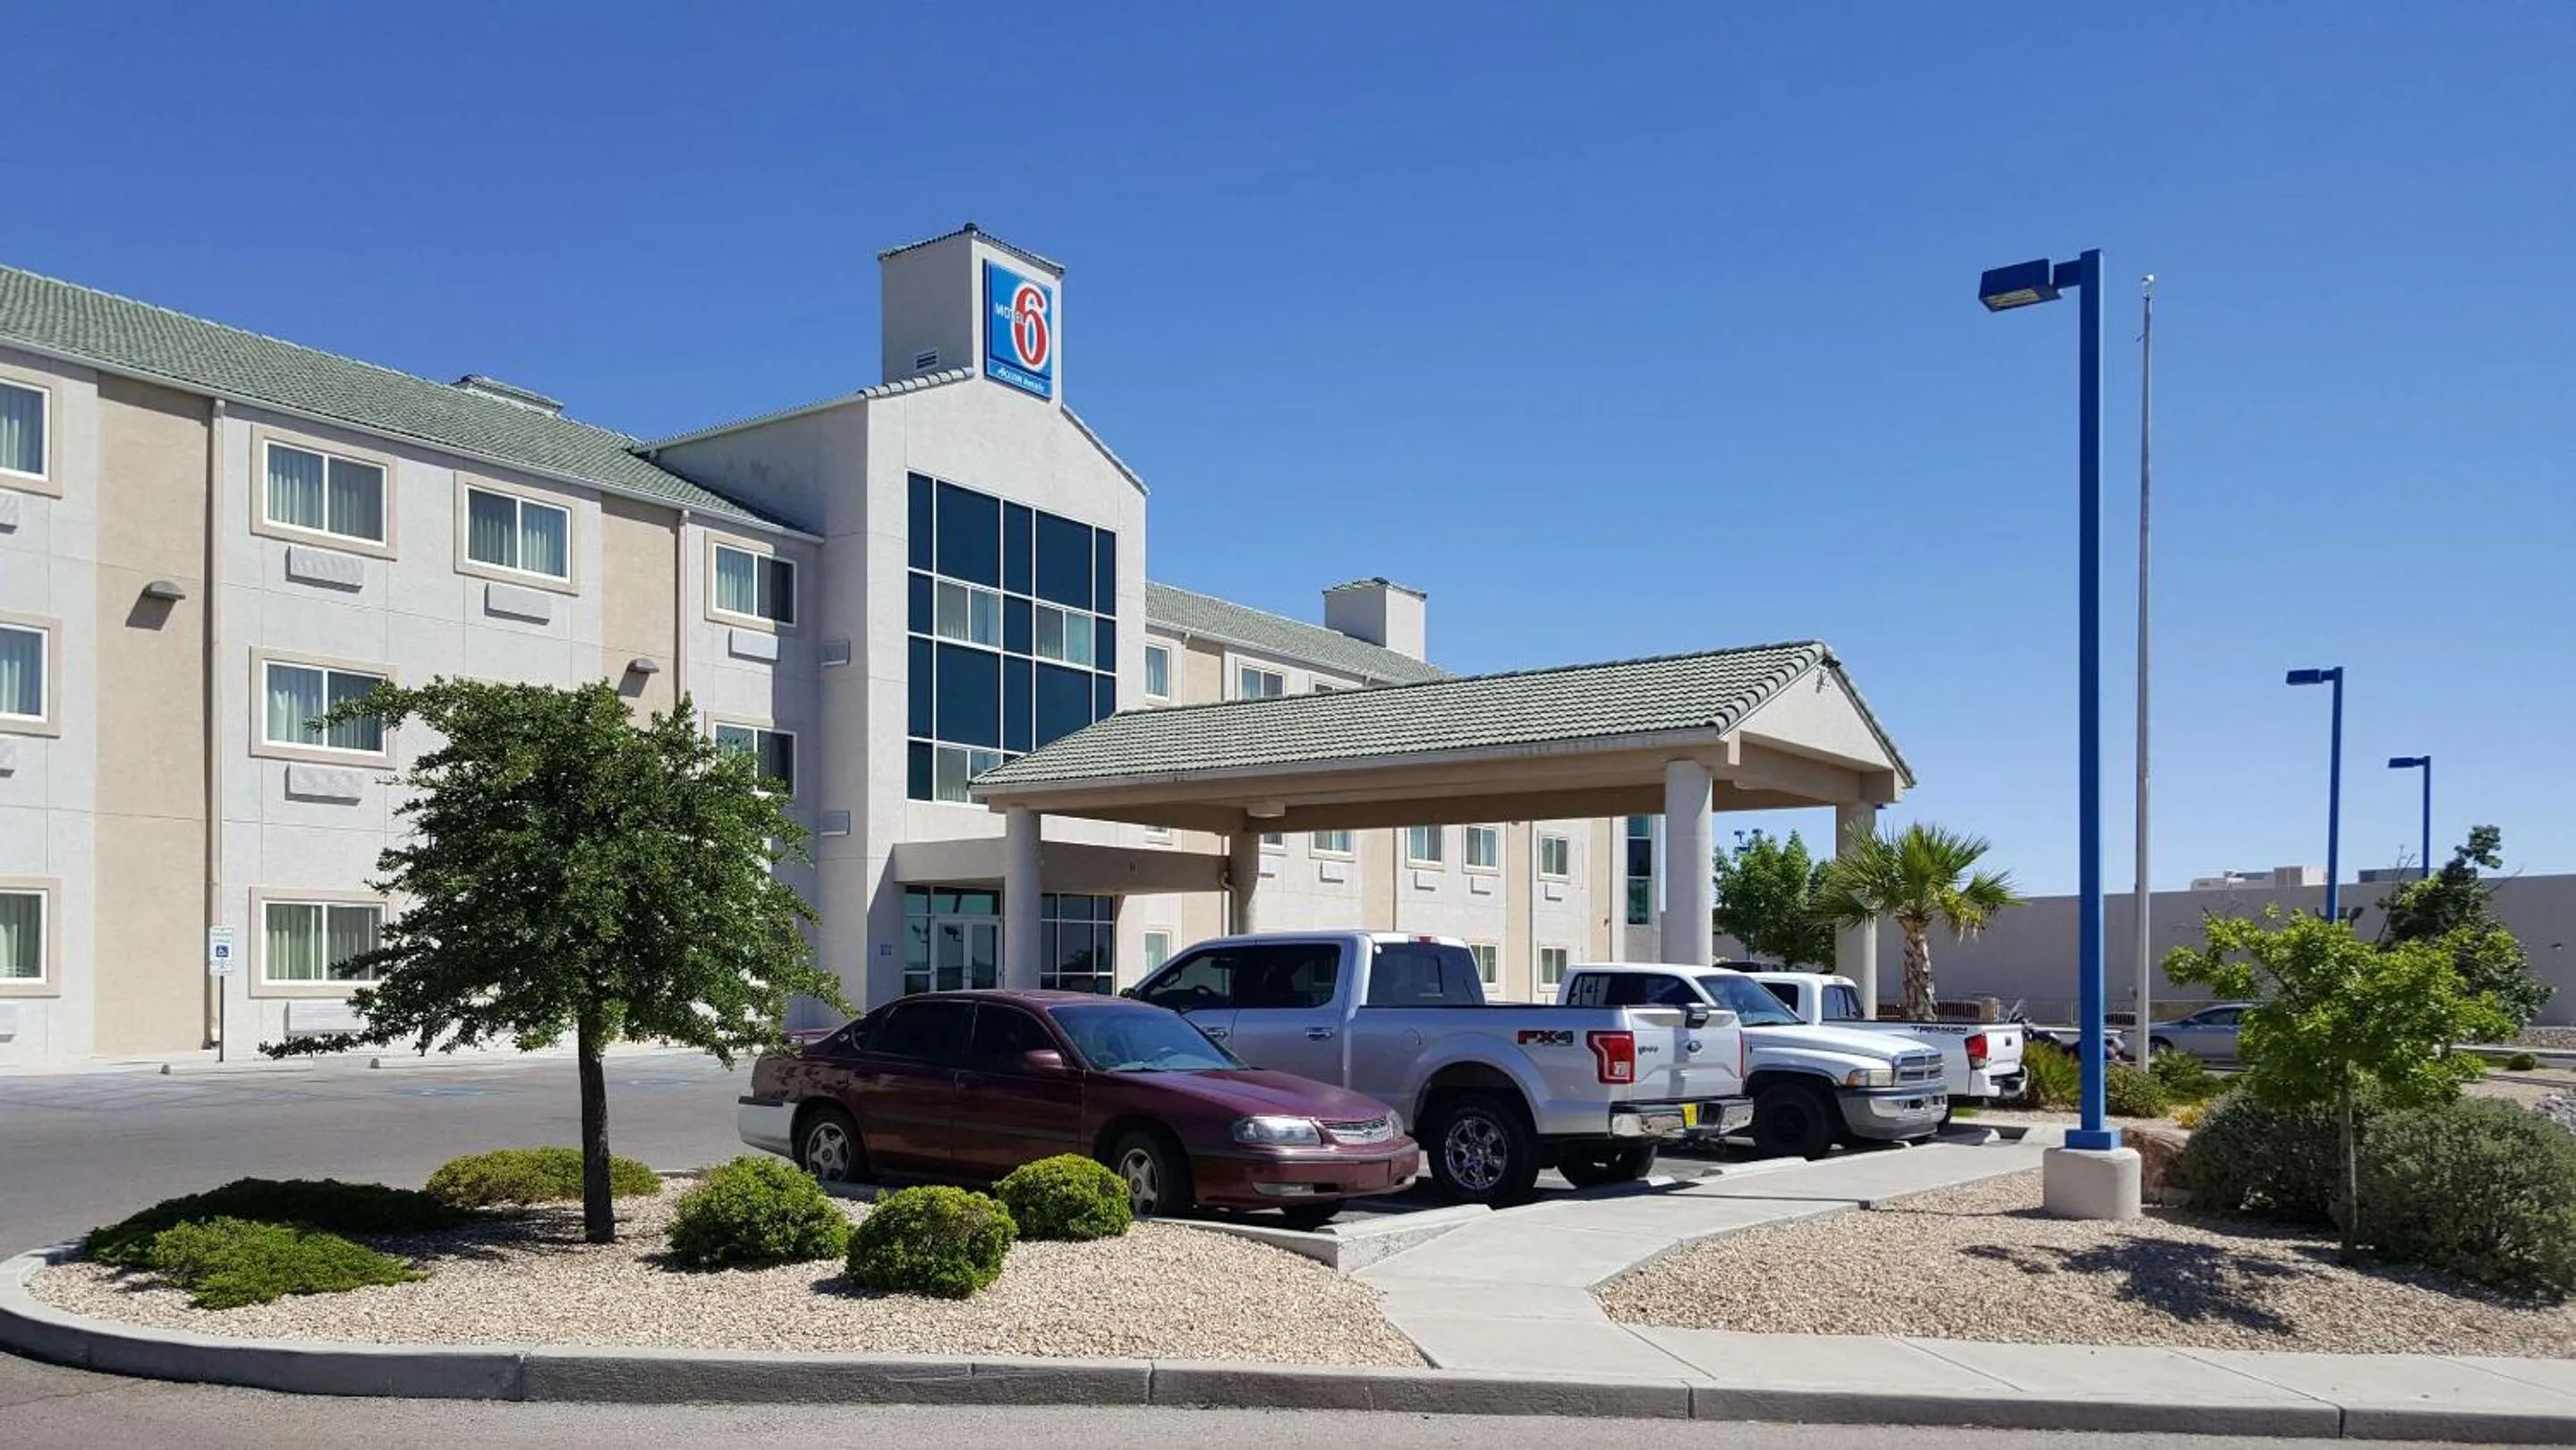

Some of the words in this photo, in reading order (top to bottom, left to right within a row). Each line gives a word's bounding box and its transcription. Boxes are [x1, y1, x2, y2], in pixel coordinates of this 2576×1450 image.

[995, 302, 1027, 326] MOTEL
[1013, 284, 1048, 369] 6
[1518, 1030, 1574, 1045] FX4
